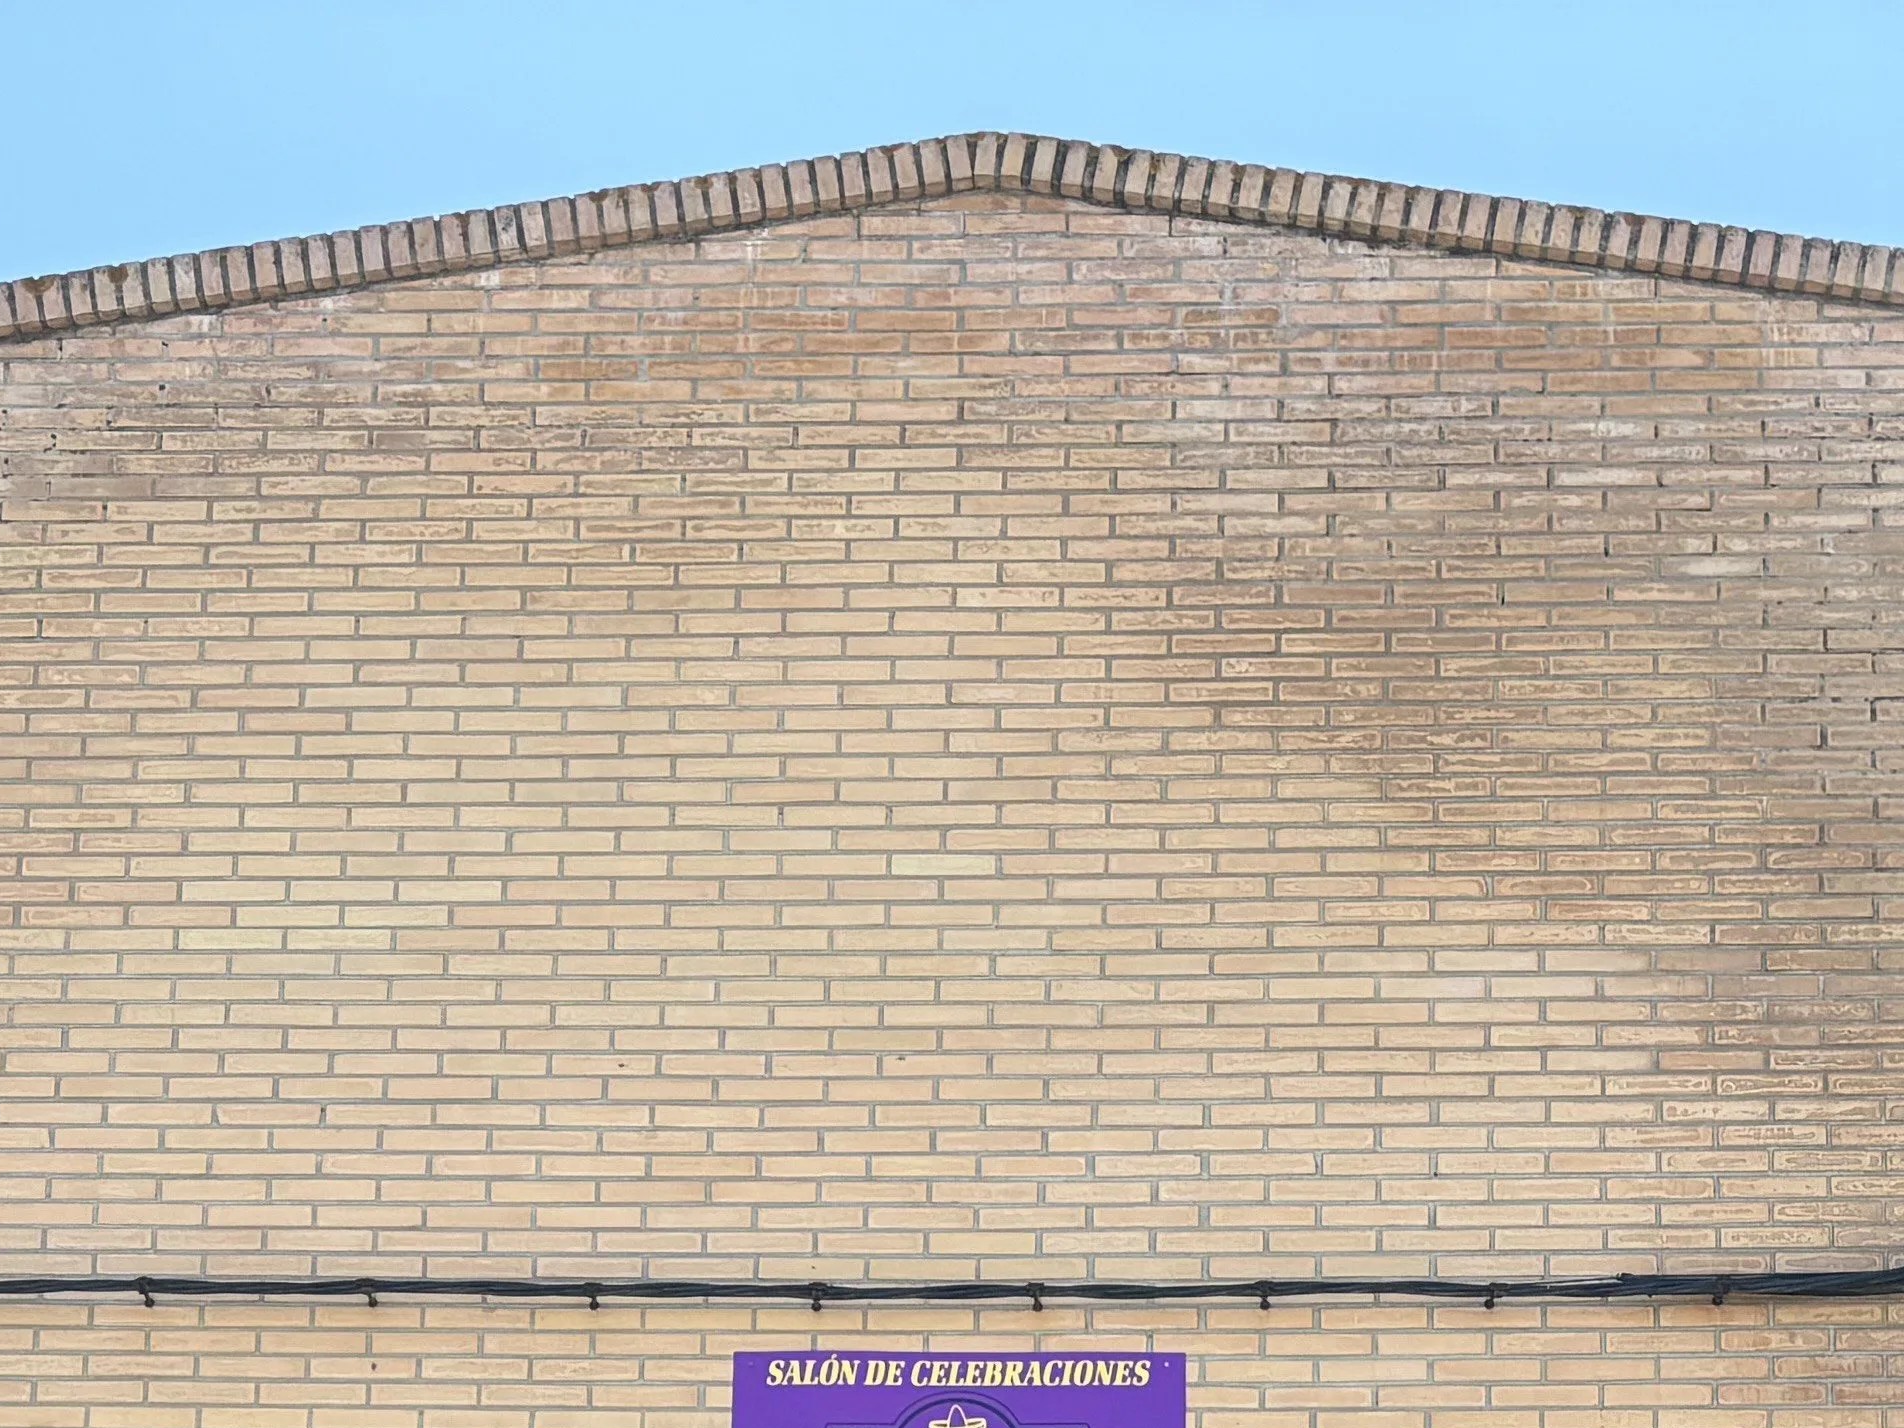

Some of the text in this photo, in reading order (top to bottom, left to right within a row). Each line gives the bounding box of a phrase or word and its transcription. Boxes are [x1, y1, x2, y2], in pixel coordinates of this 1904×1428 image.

[766, 1354, 1151, 1387] SALÓN DE CELEBRACIONES
